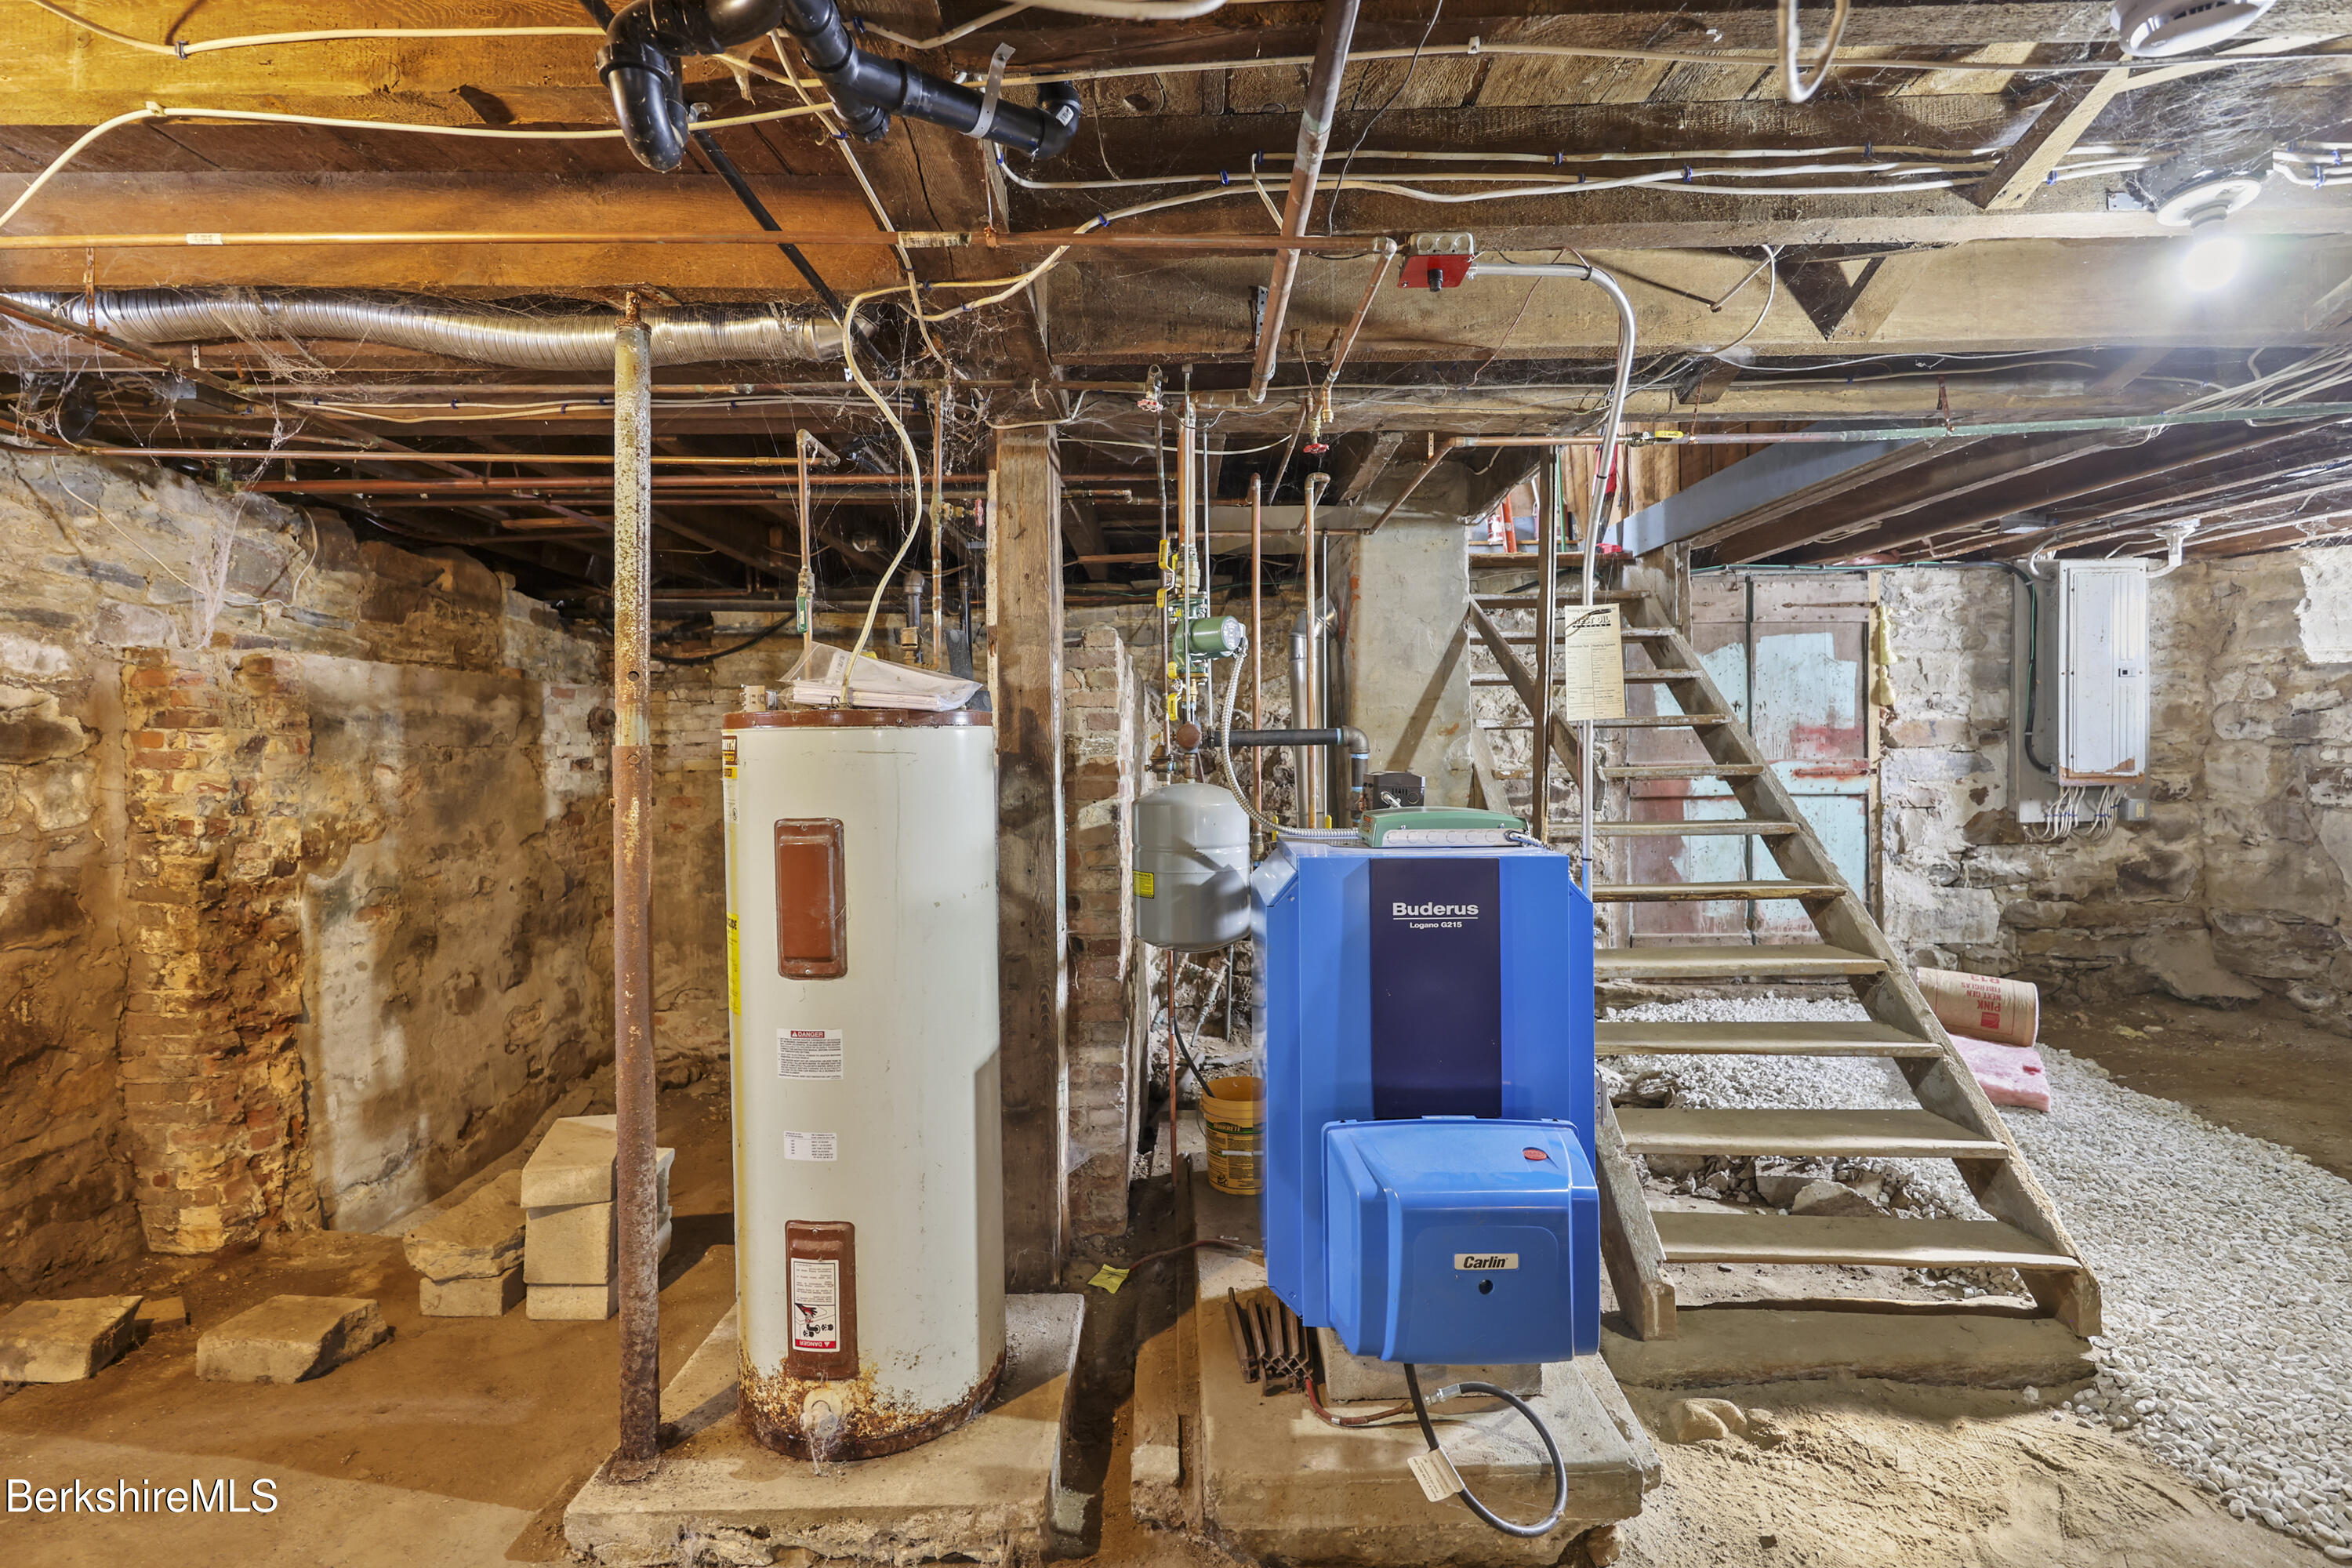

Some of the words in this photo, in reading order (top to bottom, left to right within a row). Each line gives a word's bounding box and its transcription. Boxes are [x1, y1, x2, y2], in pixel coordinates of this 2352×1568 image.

[1392, 902, 1479, 916] Buderus
[1961, 982, 2001, 993] FIBERGLAS
[1966, 989, 1981, 998] GEN
[1984, 992, 2002, 1002] NEXT
[1976, 1000, 2002, 1012] PINK
[1463, 1256, 1506, 1269] Carlin
[799, 1339, 823, 1348] DANGER
